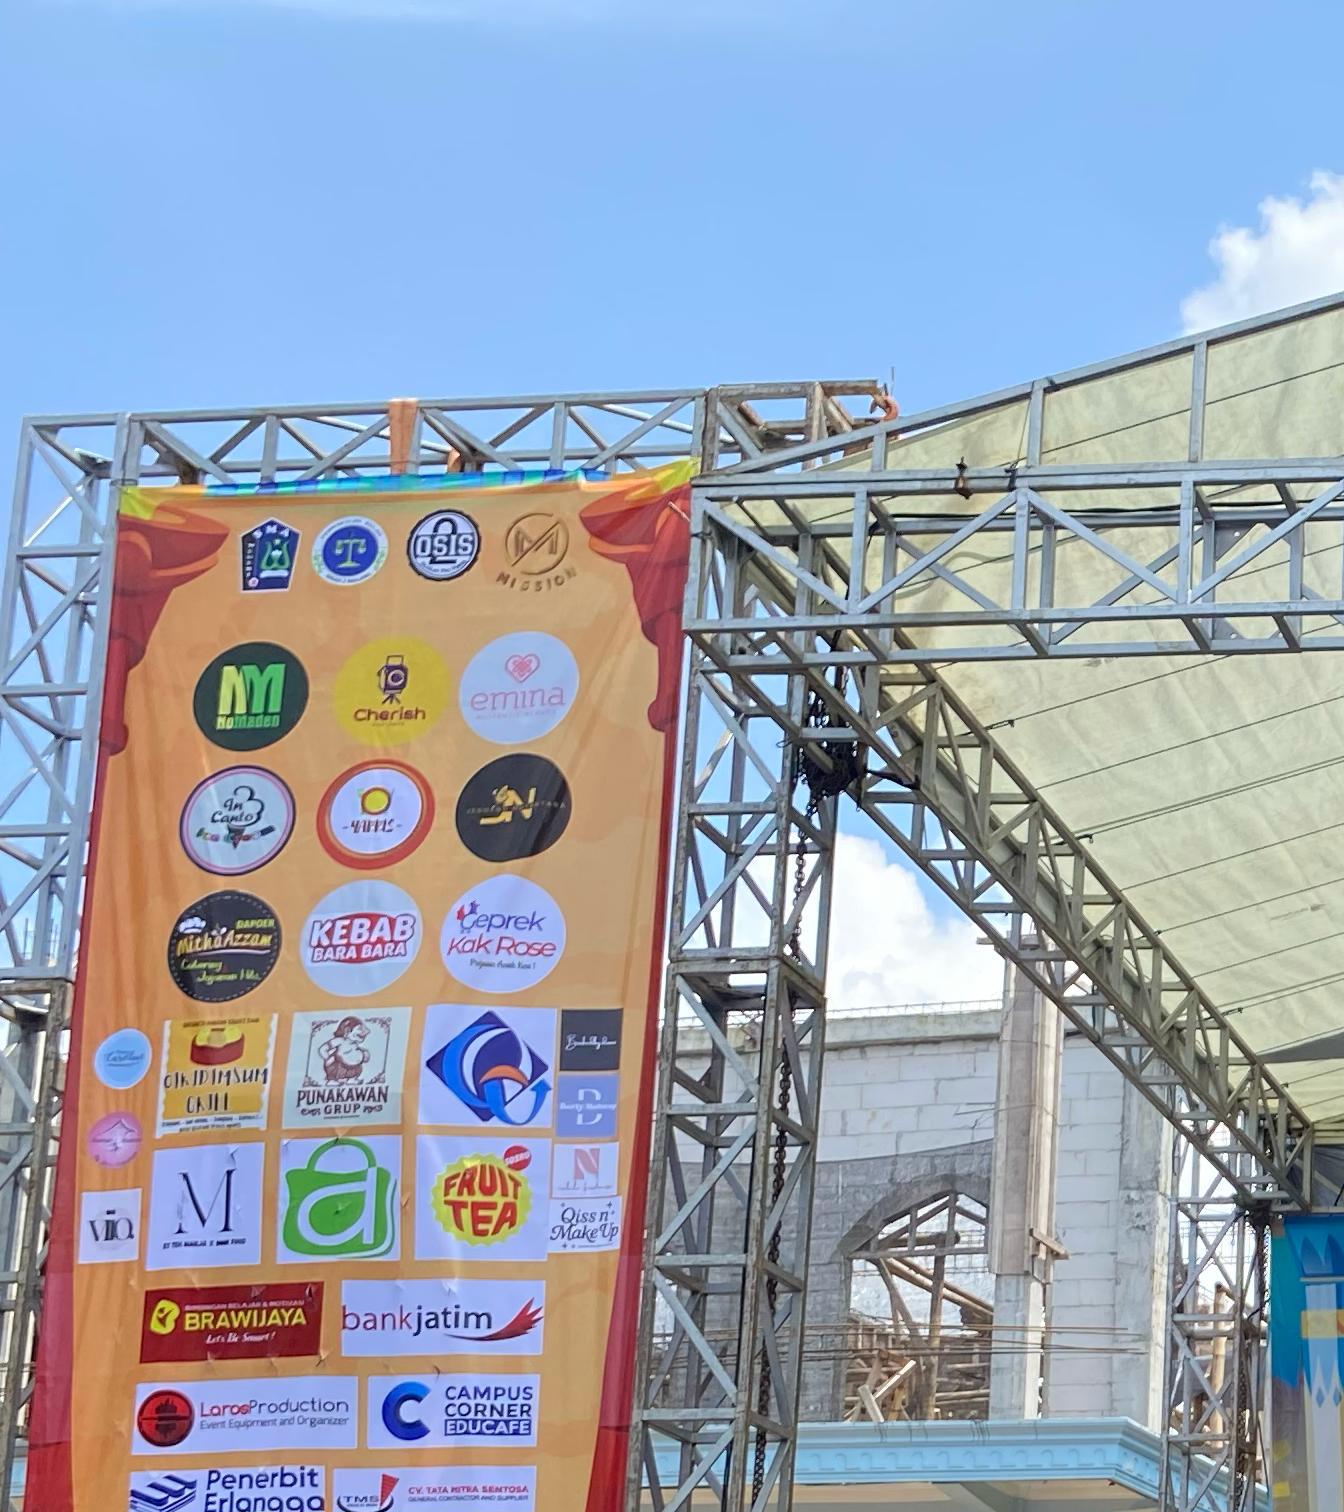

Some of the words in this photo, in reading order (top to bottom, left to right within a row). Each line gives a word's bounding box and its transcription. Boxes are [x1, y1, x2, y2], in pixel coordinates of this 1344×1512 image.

[416, 534, 473, 556] OSIS
[470, 685, 566, 711] emina
[354, 706, 426, 723] Cherish
[310, 913, 417, 947] KEBAB
[311, 943, 359, 964] BARA
[360, 940, 408, 961] BARA
[447, 936, 489, 957] Kak
[494, 936, 557, 958] Rose
[296, 1086, 389, 1107] PUNAKAWAN
[324, 1103, 361, 1115] GRUP
[443, 1164, 521, 1197] FRUIT
[443, 1200, 519, 1237] TEA
[184, 1308, 307, 1331] BRAWIJAYA
[342, 1303, 493, 1336] bankjatim
[444, 1386, 534, 1402] CAMPUS
[200, 1416, 226, 1429] Event
[228, 1415, 277, 1430] Equipment
[279, 1415, 295, 1427] and
[297, 1414, 350, 1429] Organizer
[444, 1403, 533, 1419] CORNER
[446, 1420, 531, 1435] EDUCAFE
[206, 1466, 320, 1490] Penerbit
